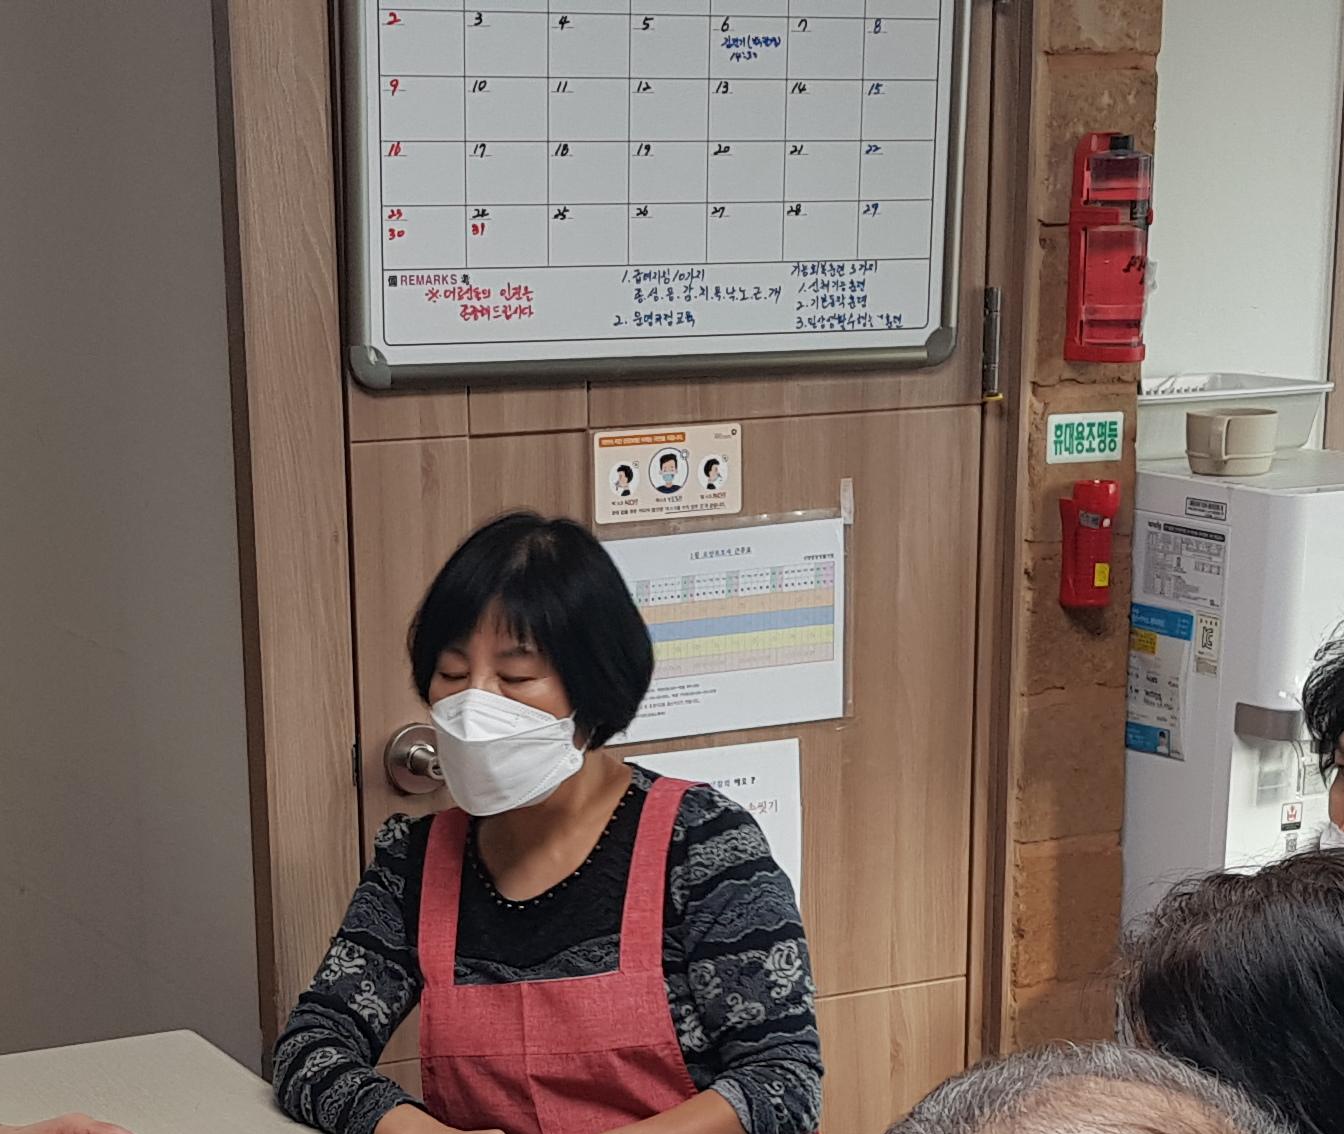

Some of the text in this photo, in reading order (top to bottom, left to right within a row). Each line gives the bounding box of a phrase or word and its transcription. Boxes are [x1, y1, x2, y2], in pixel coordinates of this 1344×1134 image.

[387, 11, 882, 34] 2 3 4 5 6 7 8
[389, 79, 883, 96] 9 10 11 12 13 14 15
[388, 141, 882, 158] 16 17 18 19 20 21 22
[387, 208, 403, 219] 23
[553, 206, 570, 220] 25
[636, 205, 649, 217] 26
[711, 206, 726, 218] 27
[787, 204, 802, 216] 28
[863, 203, 879, 217] 29
[388, 222, 486, 240] 30 31
[400, 273, 458, 286] REMARKS
[1053, 420, 1118, 456] 휴대용조명등
